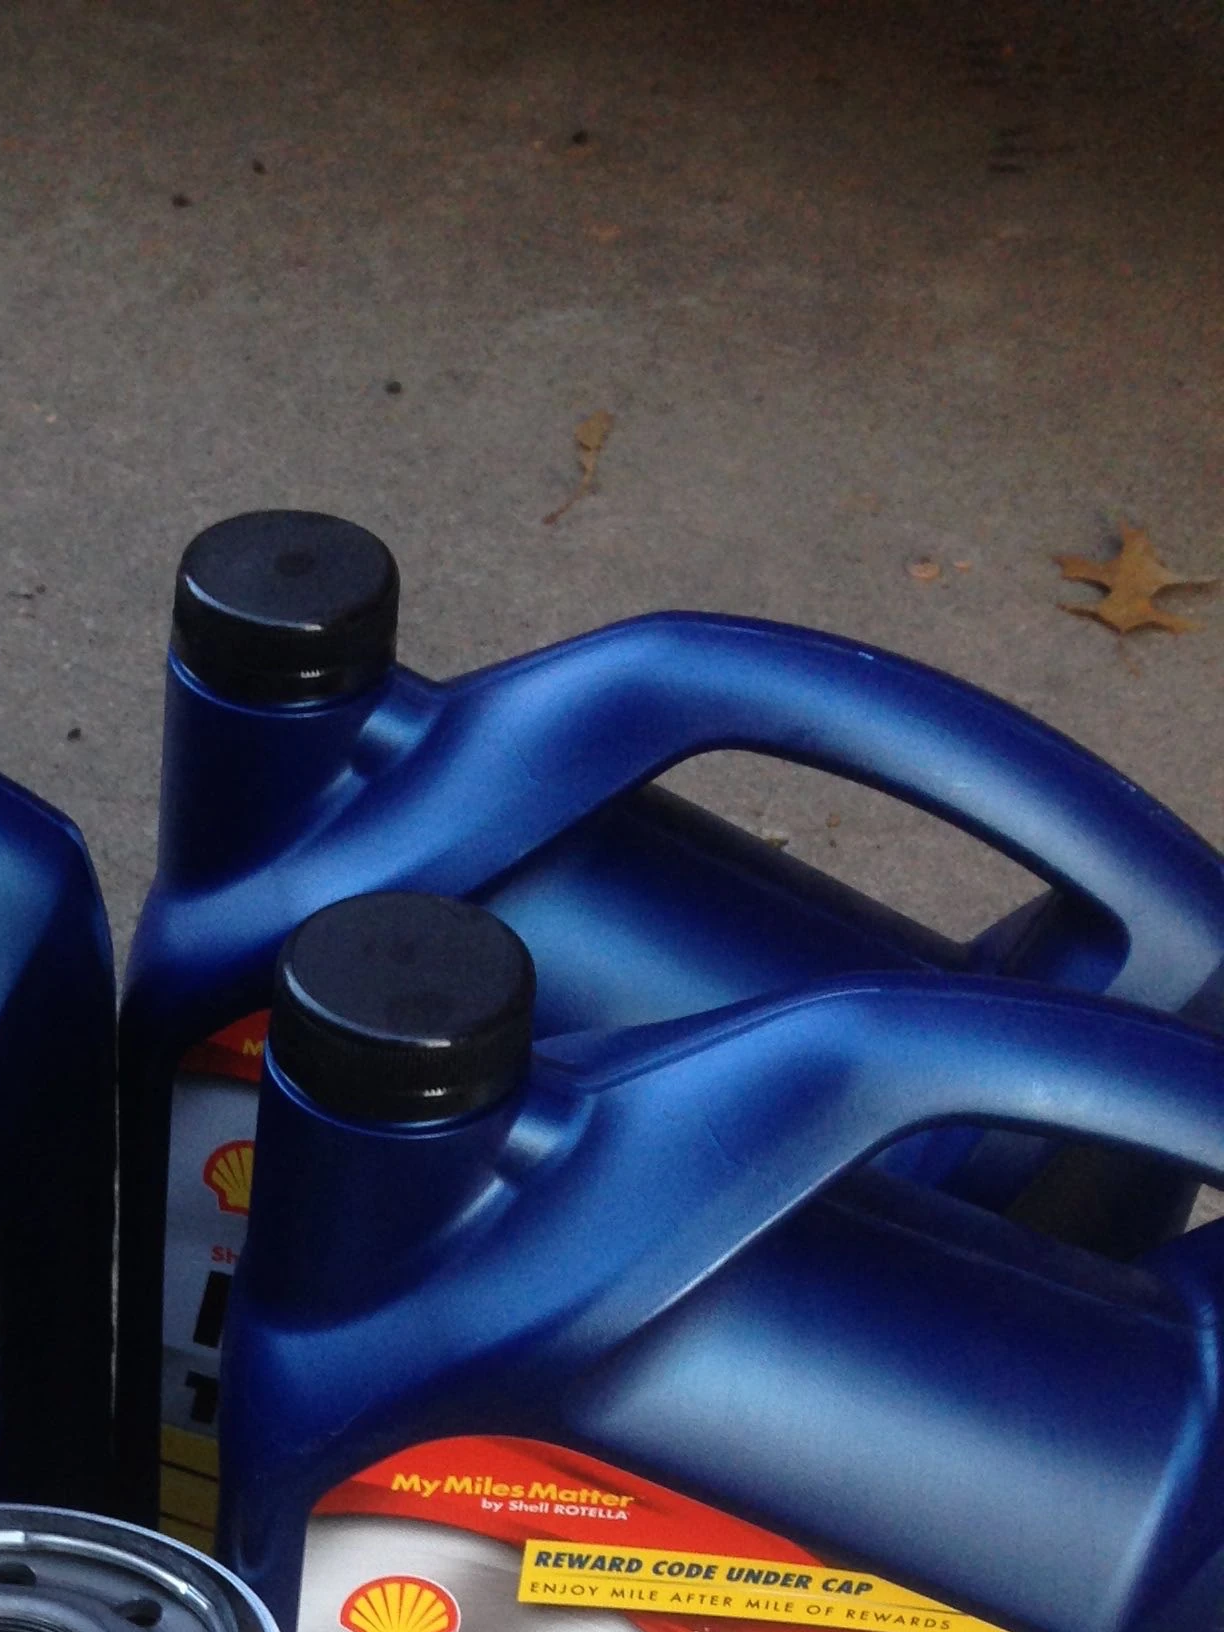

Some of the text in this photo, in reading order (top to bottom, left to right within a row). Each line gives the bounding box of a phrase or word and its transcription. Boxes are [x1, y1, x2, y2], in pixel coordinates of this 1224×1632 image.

[242, 1036, 266, 1056] M
[391, 1473, 635, 1508] My Miles Matter
[481, 1498, 629, 1521] by Shell ROTELLA
[534, 1550, 874, 1597] REWARD CODE UNDER CAP
[530, 1581, 952, 1632] ENJOY MILE AFTER MILE OF REWARDS
